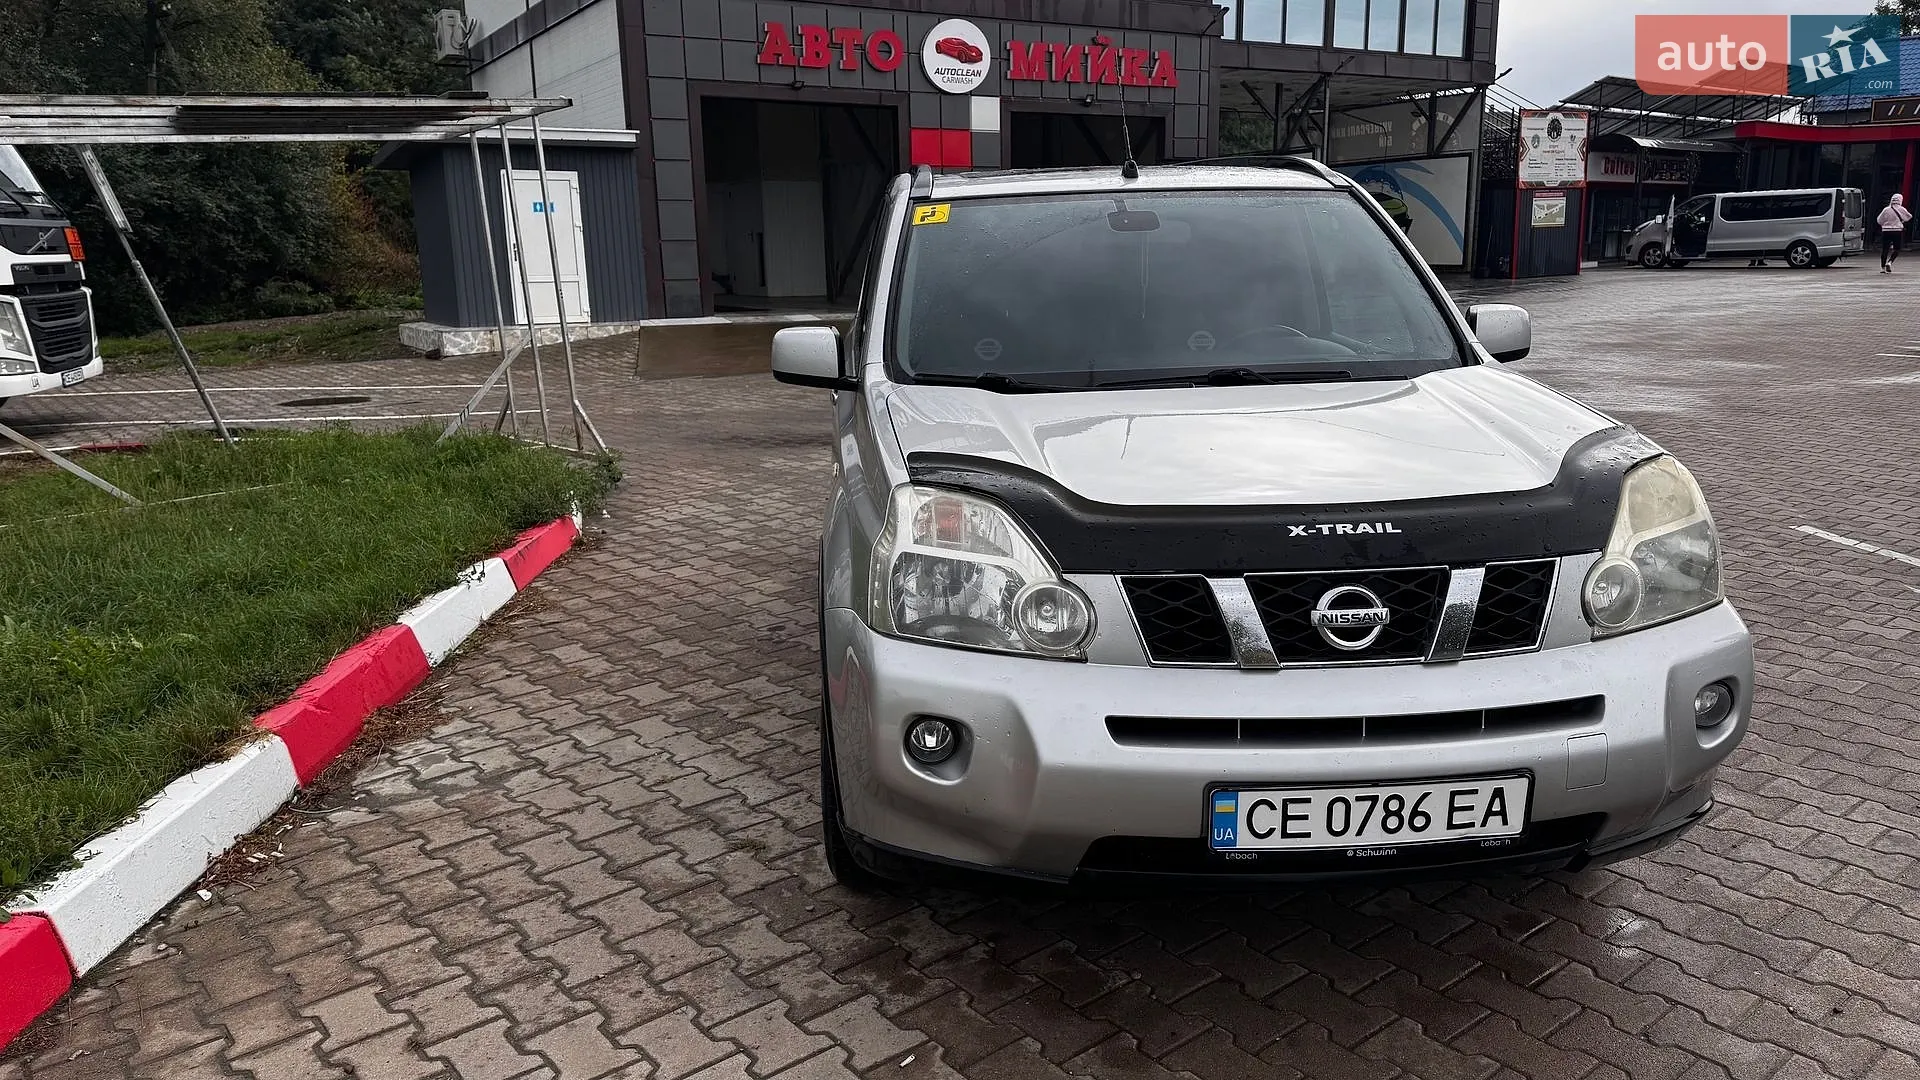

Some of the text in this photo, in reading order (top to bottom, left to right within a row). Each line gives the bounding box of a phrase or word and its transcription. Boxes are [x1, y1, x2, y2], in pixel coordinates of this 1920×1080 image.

[757, 21, 1179, 88] АВТО МИЙКА
[934, 67, 982, 78] AUTOCLEAN
[941, 75, 974, 85] CARWASH
[1287, 522, 1402, 537] X-TRAIL
[1321, 611, 1386, 625] NISSAN
[1213, 786, 1510, 842] UA CE 0786 EA
[1356, 847, 1397, 857] Schwinn
[1480, 839, 1511, 847] Lebah
